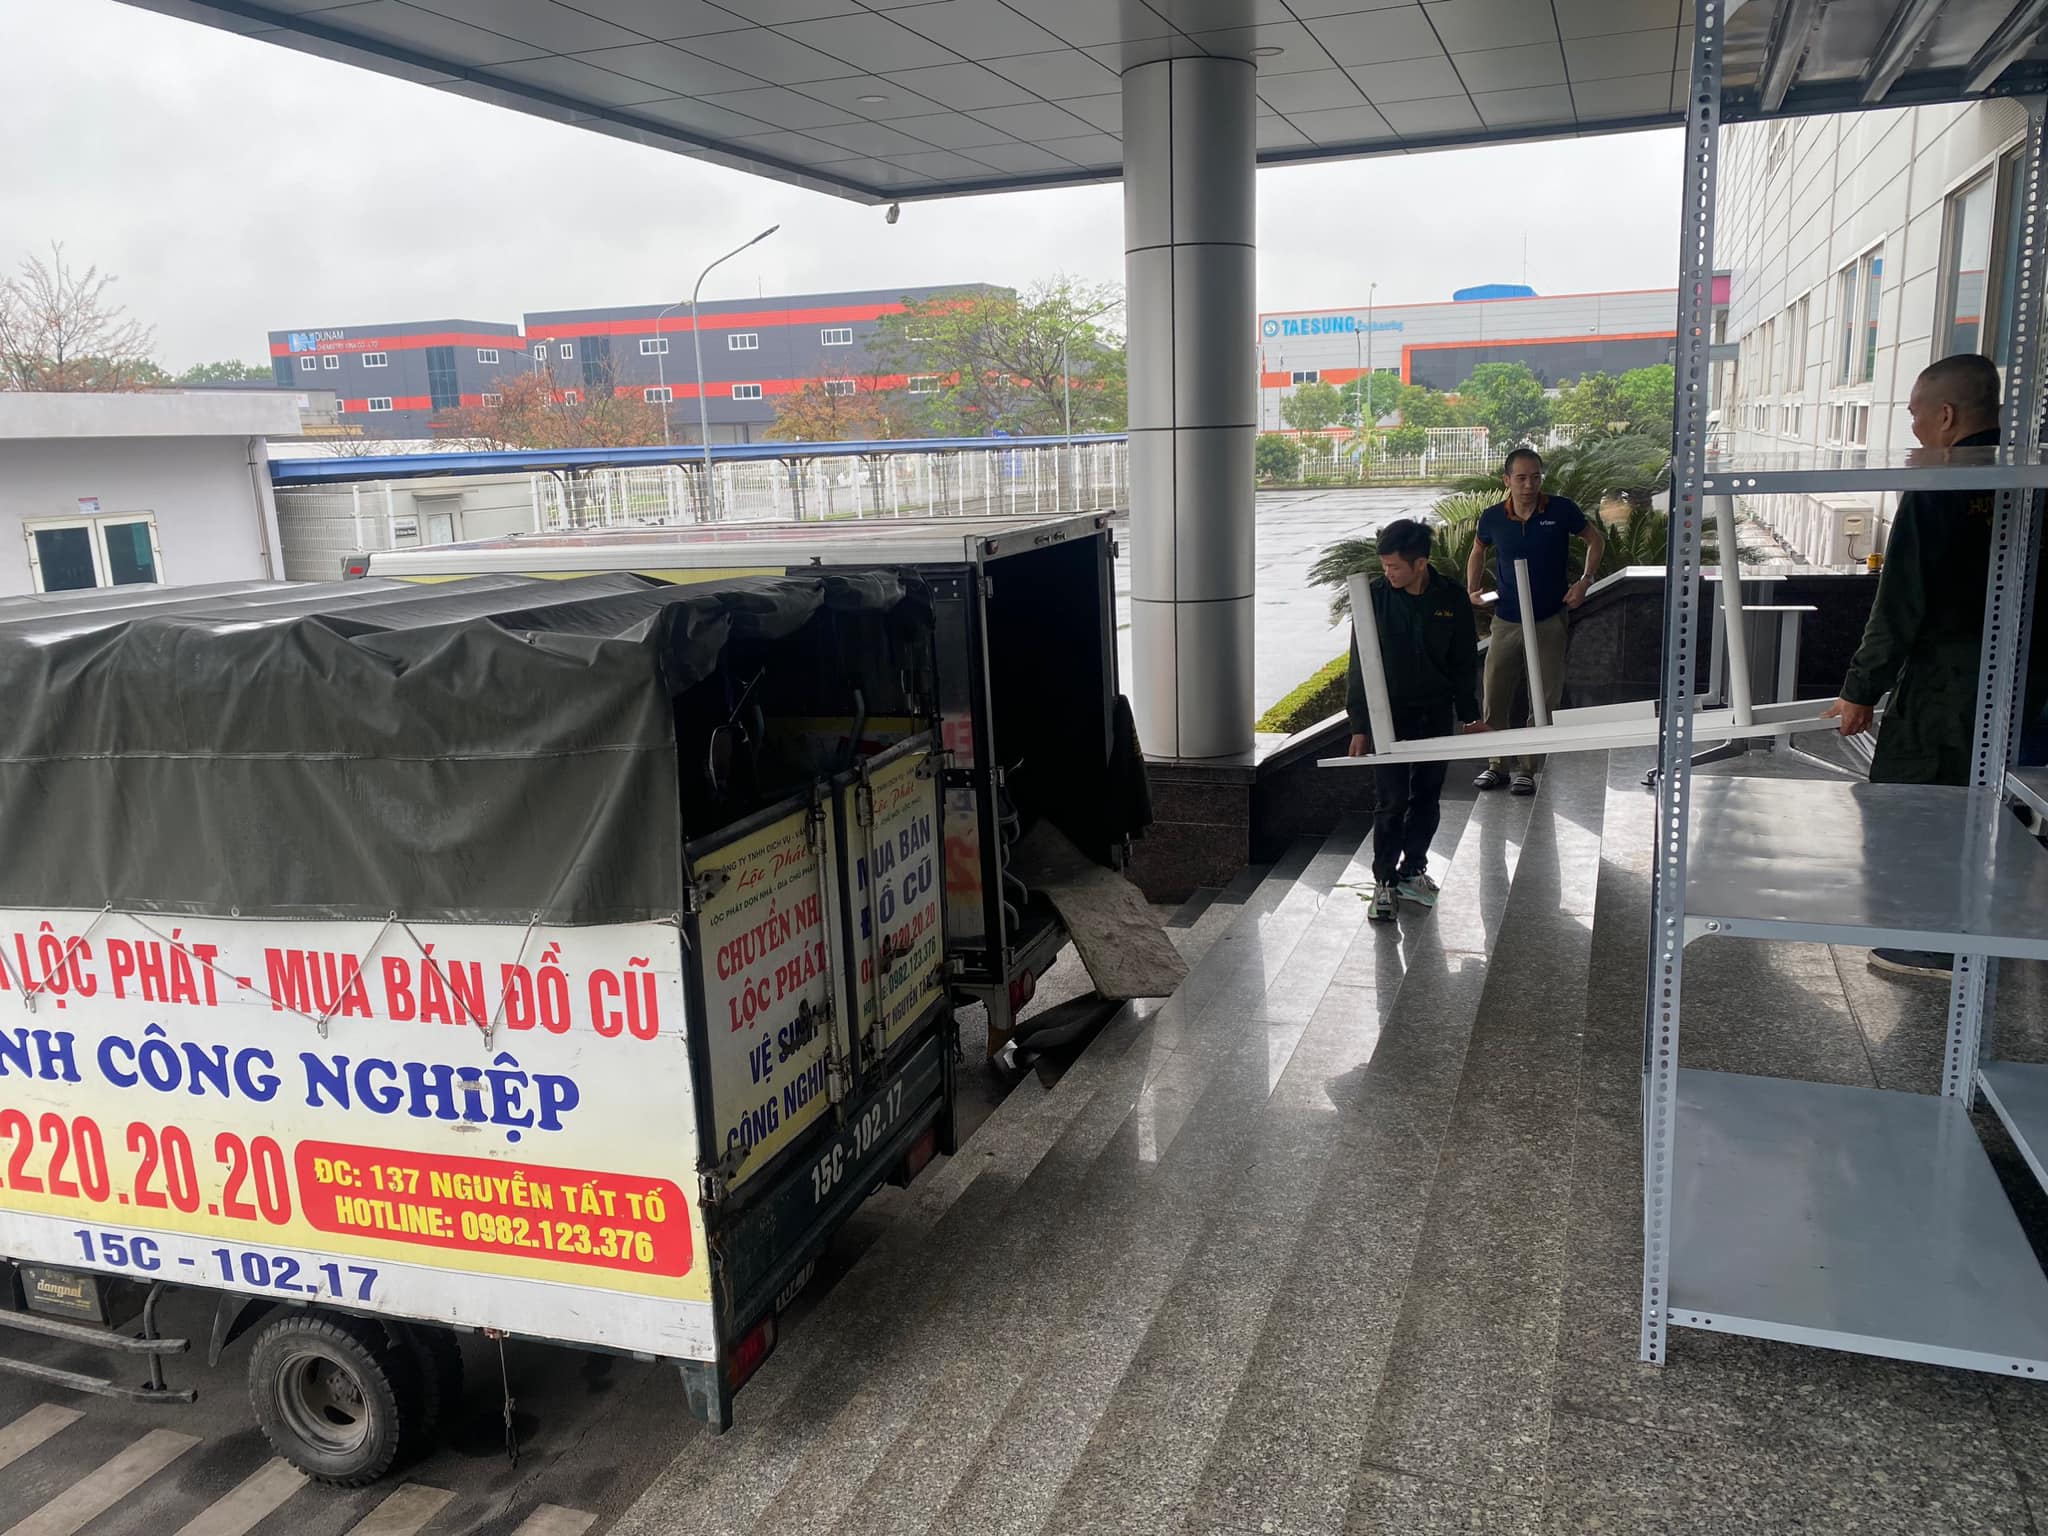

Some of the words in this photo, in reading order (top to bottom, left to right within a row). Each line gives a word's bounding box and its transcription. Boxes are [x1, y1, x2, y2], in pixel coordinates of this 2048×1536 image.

[1282, 316, 1355, 336] TAESUNG
[720, 861, 737, 873] ÔNG
[769, 845, 807, 877] Phát
[899, 814, 931, 862] BÁN
[903, 856, 932, 905] CŨ
[717, 897, 791, 980] CHUYỂN
[794, 894, 824, 935] NH
[14, 921, 97, 1008] LỘC
[106, 929, 218, 1006] PHÁT
[264, 948, 373, 1018] MUA
[381, 944, 488, 1027] BÁN
[501, 942, 571, 1034] ĐỒ
[588, 957, 659, 1040] CŨ
[729, 977, 771, 1032] LỘC
[97, 1023, 281, 1102] CÔNG
[299, 1052, 579, 1143] NGHIỆP
[749, 1032, 773, 1084] VỆ
[784, 1050, 829, 1120] NGHI
[314, 1157, 362, 1188] ĐC:
[369, 1165, 419, 1194] 137
[430, 1170, 554, 1210] NGUYỄN
[560, 1180, 617, 1217] TẤT
[625, 1187, 666, 1223] TỐ
[335, 1195, 455, 1239] HOTLINE:
[460, 1211, 655, 1263] 0982.123.376
[74, 1230, 161, 1271] 15C
[212, 1248, 378, 1301] 102.17
